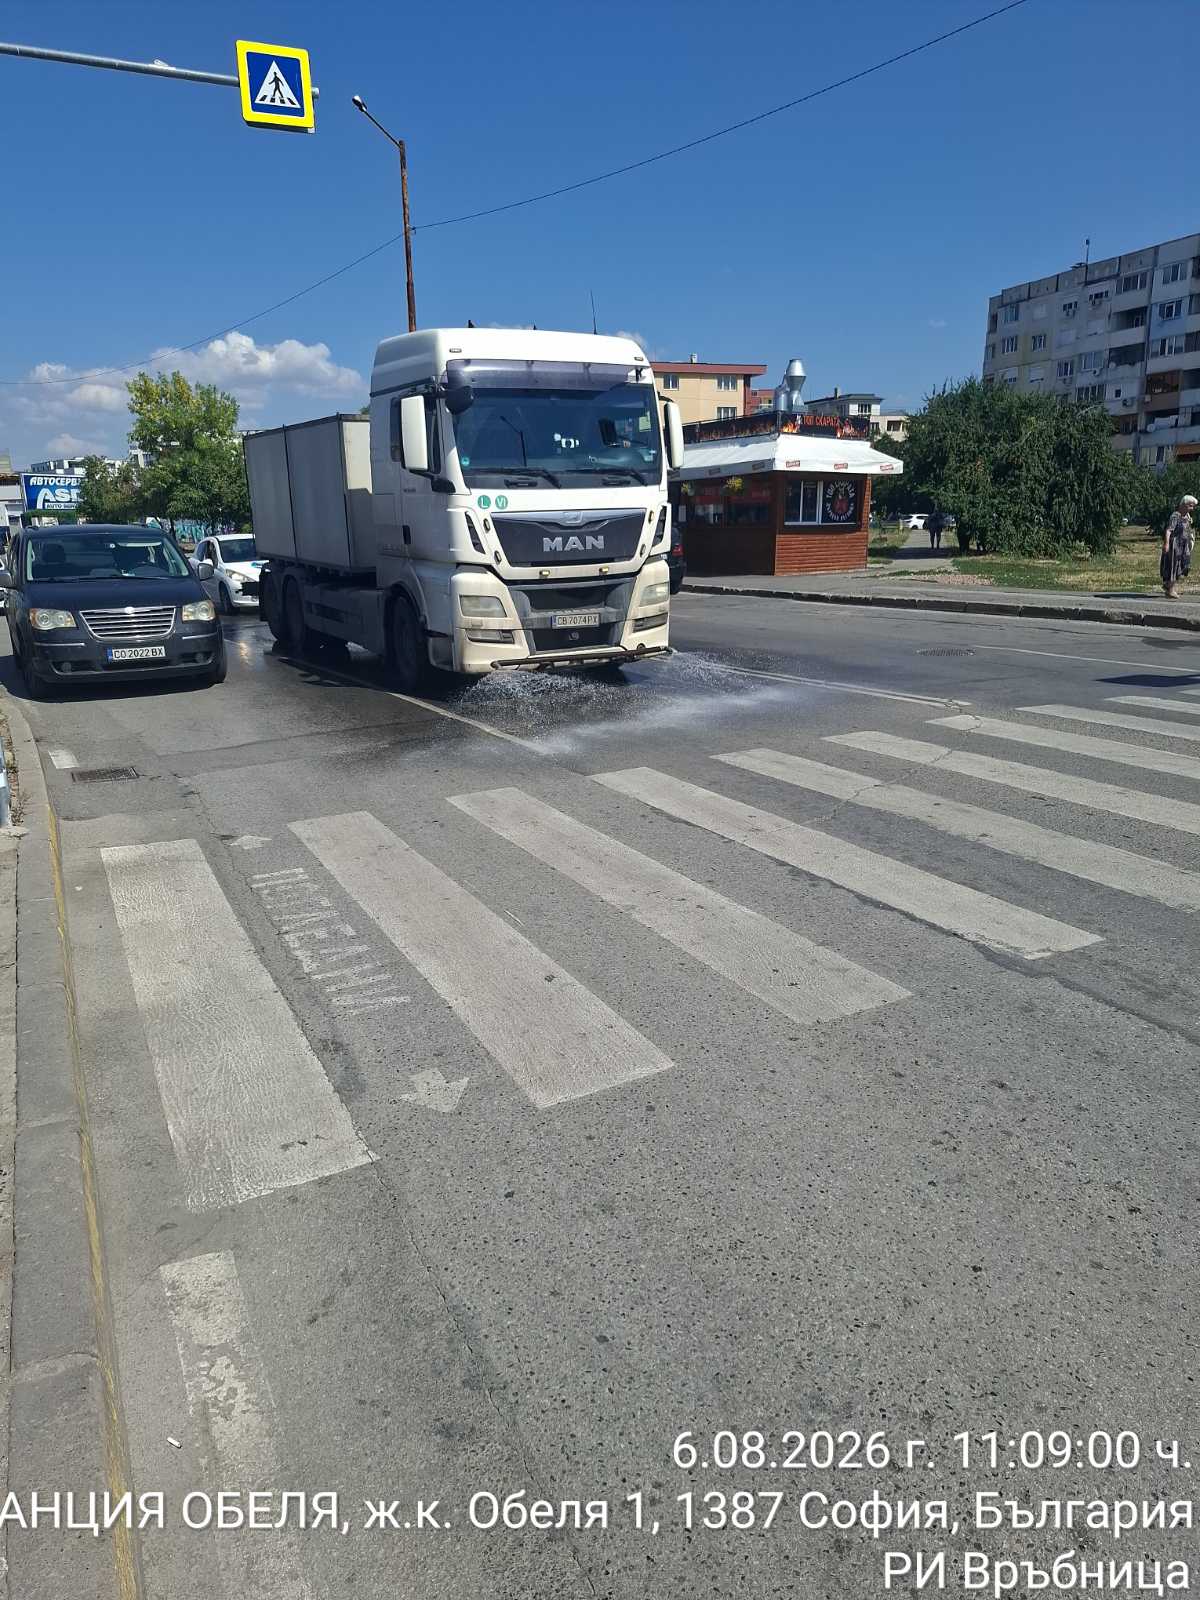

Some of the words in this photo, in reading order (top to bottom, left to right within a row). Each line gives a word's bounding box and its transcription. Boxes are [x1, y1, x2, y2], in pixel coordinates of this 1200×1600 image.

[30, 476, 82, 486] АВТОСЕРВ
[543, 535, 605, 552] MAN
[557, 616, 568, 625] CB
[569, 615, 587, 625] 7074
[113, 650, 127, 659] CO
[127, 648, 151, 658] 2022
[151, 647, 164, 657] BX
